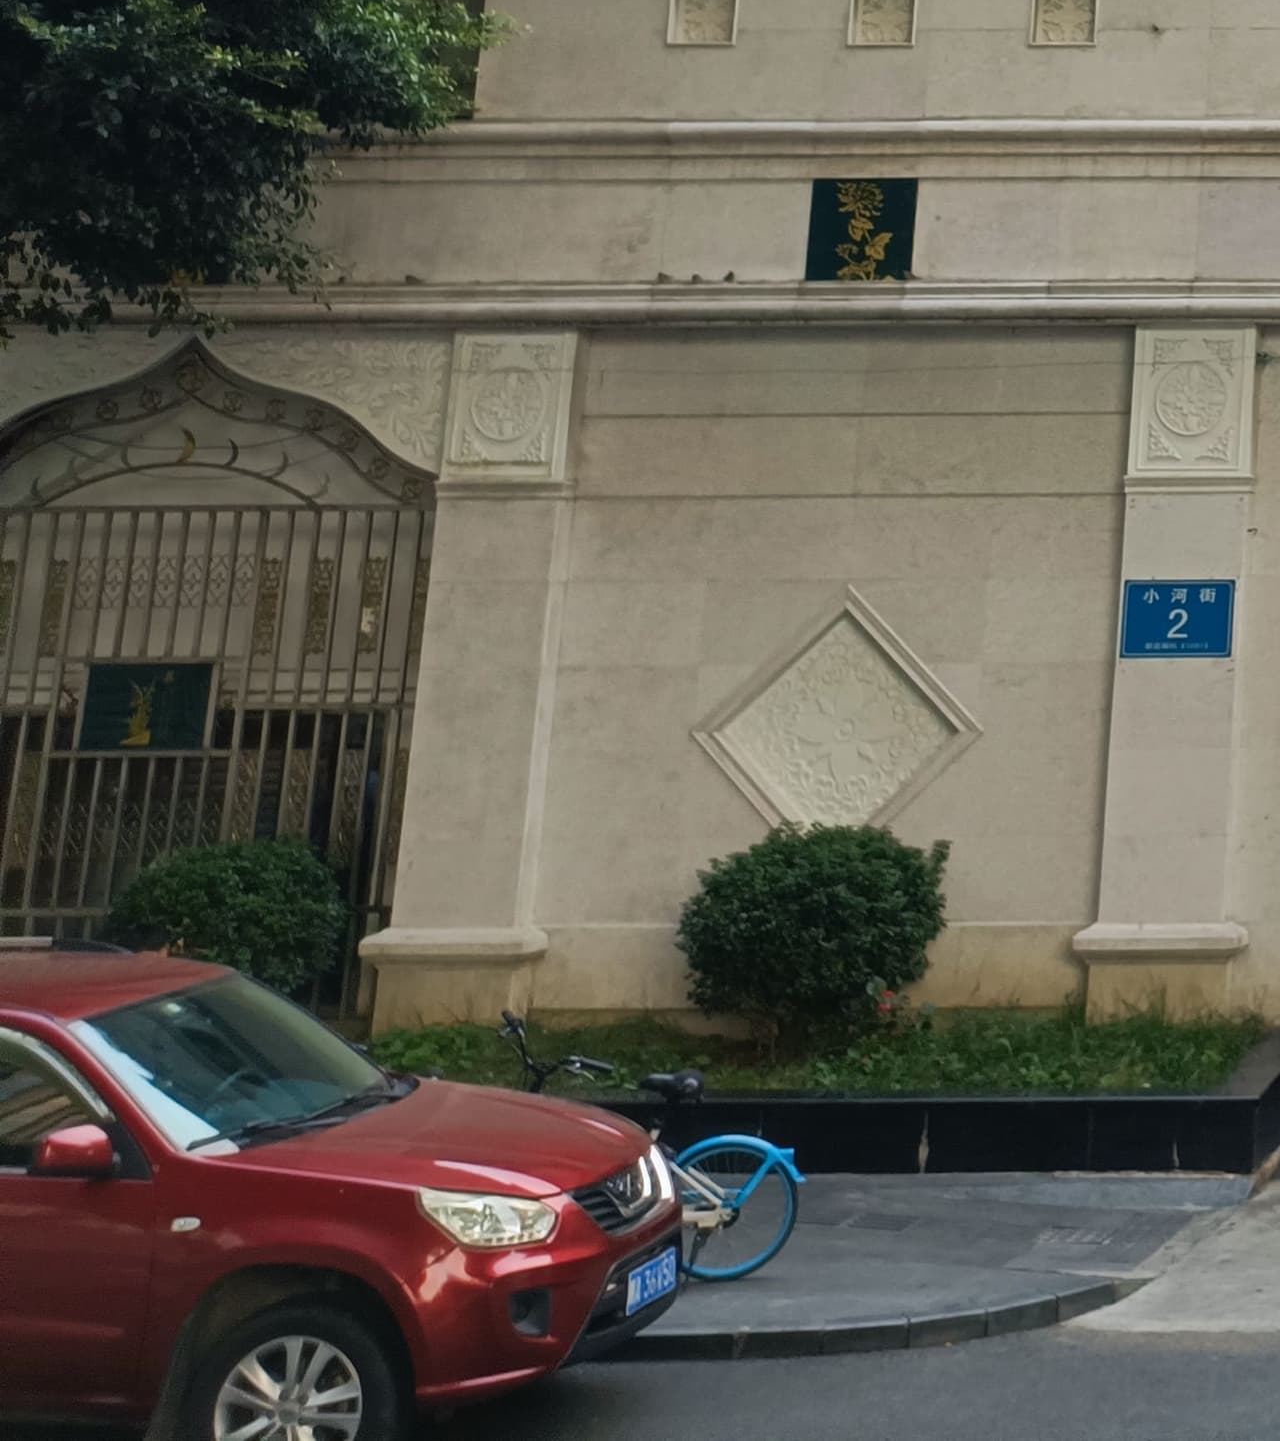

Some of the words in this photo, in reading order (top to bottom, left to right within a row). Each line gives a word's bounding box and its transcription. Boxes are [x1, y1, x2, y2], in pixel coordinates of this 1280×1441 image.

[1143, 587, 1217, 604] 小河街
[1167, 608, 1189, 639] 2
